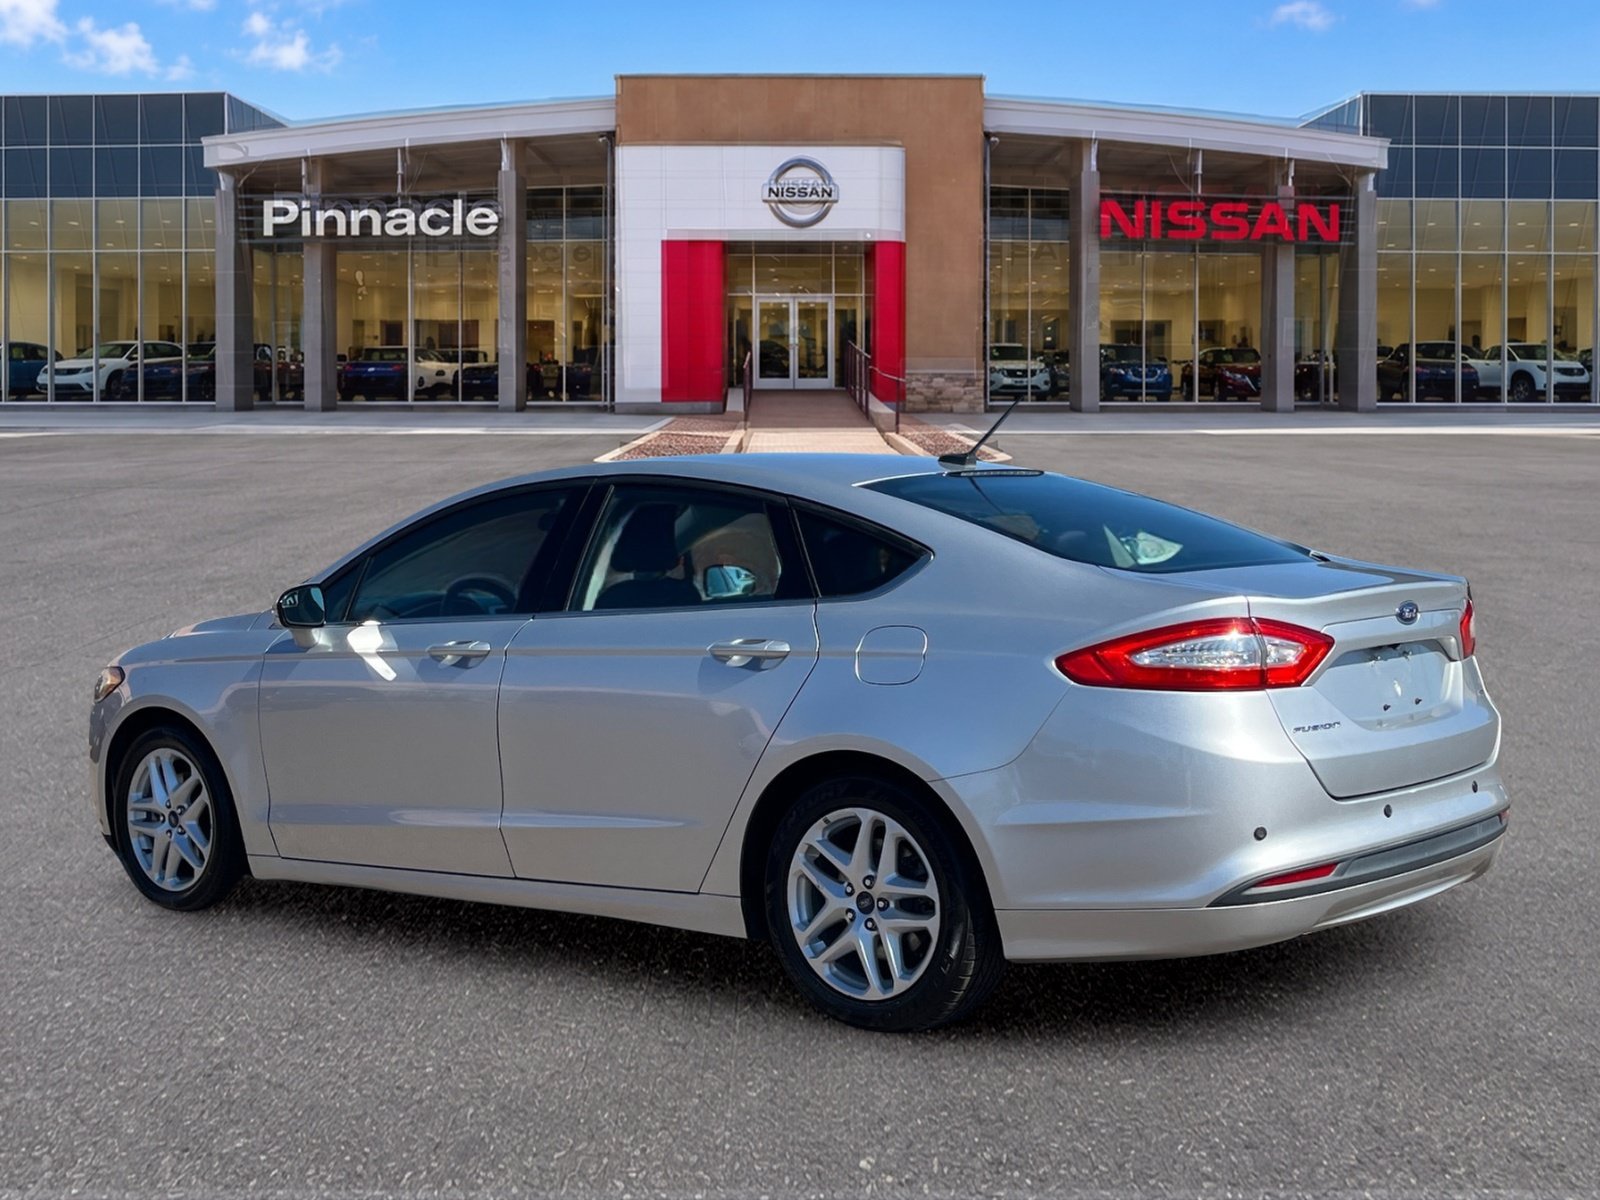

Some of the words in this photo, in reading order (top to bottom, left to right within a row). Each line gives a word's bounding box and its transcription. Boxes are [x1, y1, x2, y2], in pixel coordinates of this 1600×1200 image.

[767, 186, 833, 198] NISSAN
[262, 198, 499, 237] Pinnacle
[1100, 200, 1340, 242] NISSAN
